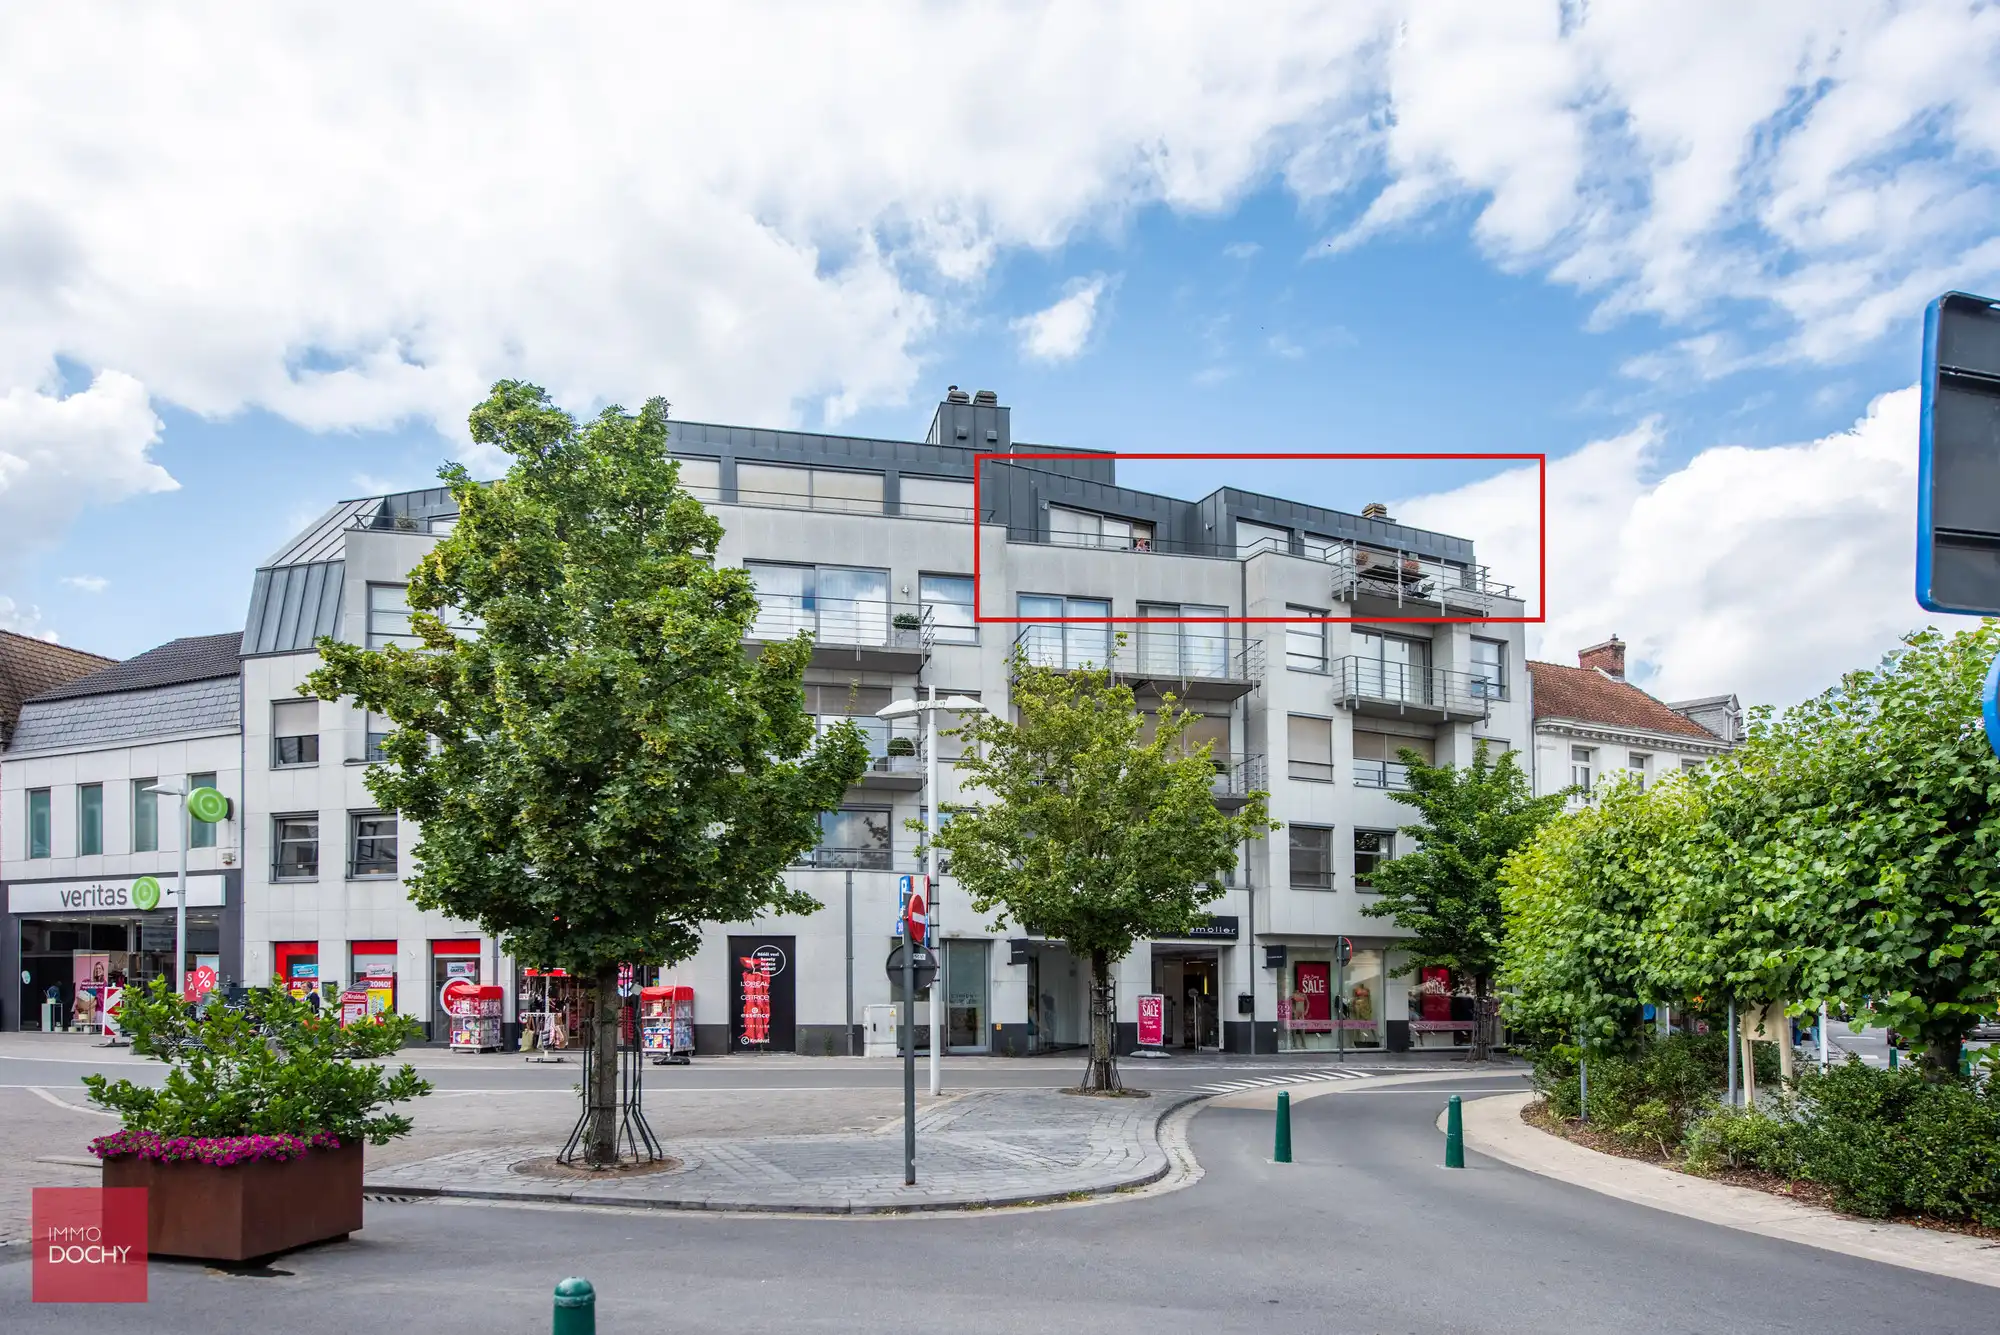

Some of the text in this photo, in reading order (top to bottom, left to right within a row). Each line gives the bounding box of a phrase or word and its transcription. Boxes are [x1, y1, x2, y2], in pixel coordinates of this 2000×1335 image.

[60, 884, 128, 907] veritas
[1302, 979, 1325, 994] SALE
[1142, 1003, 1159, 1017] SALE
